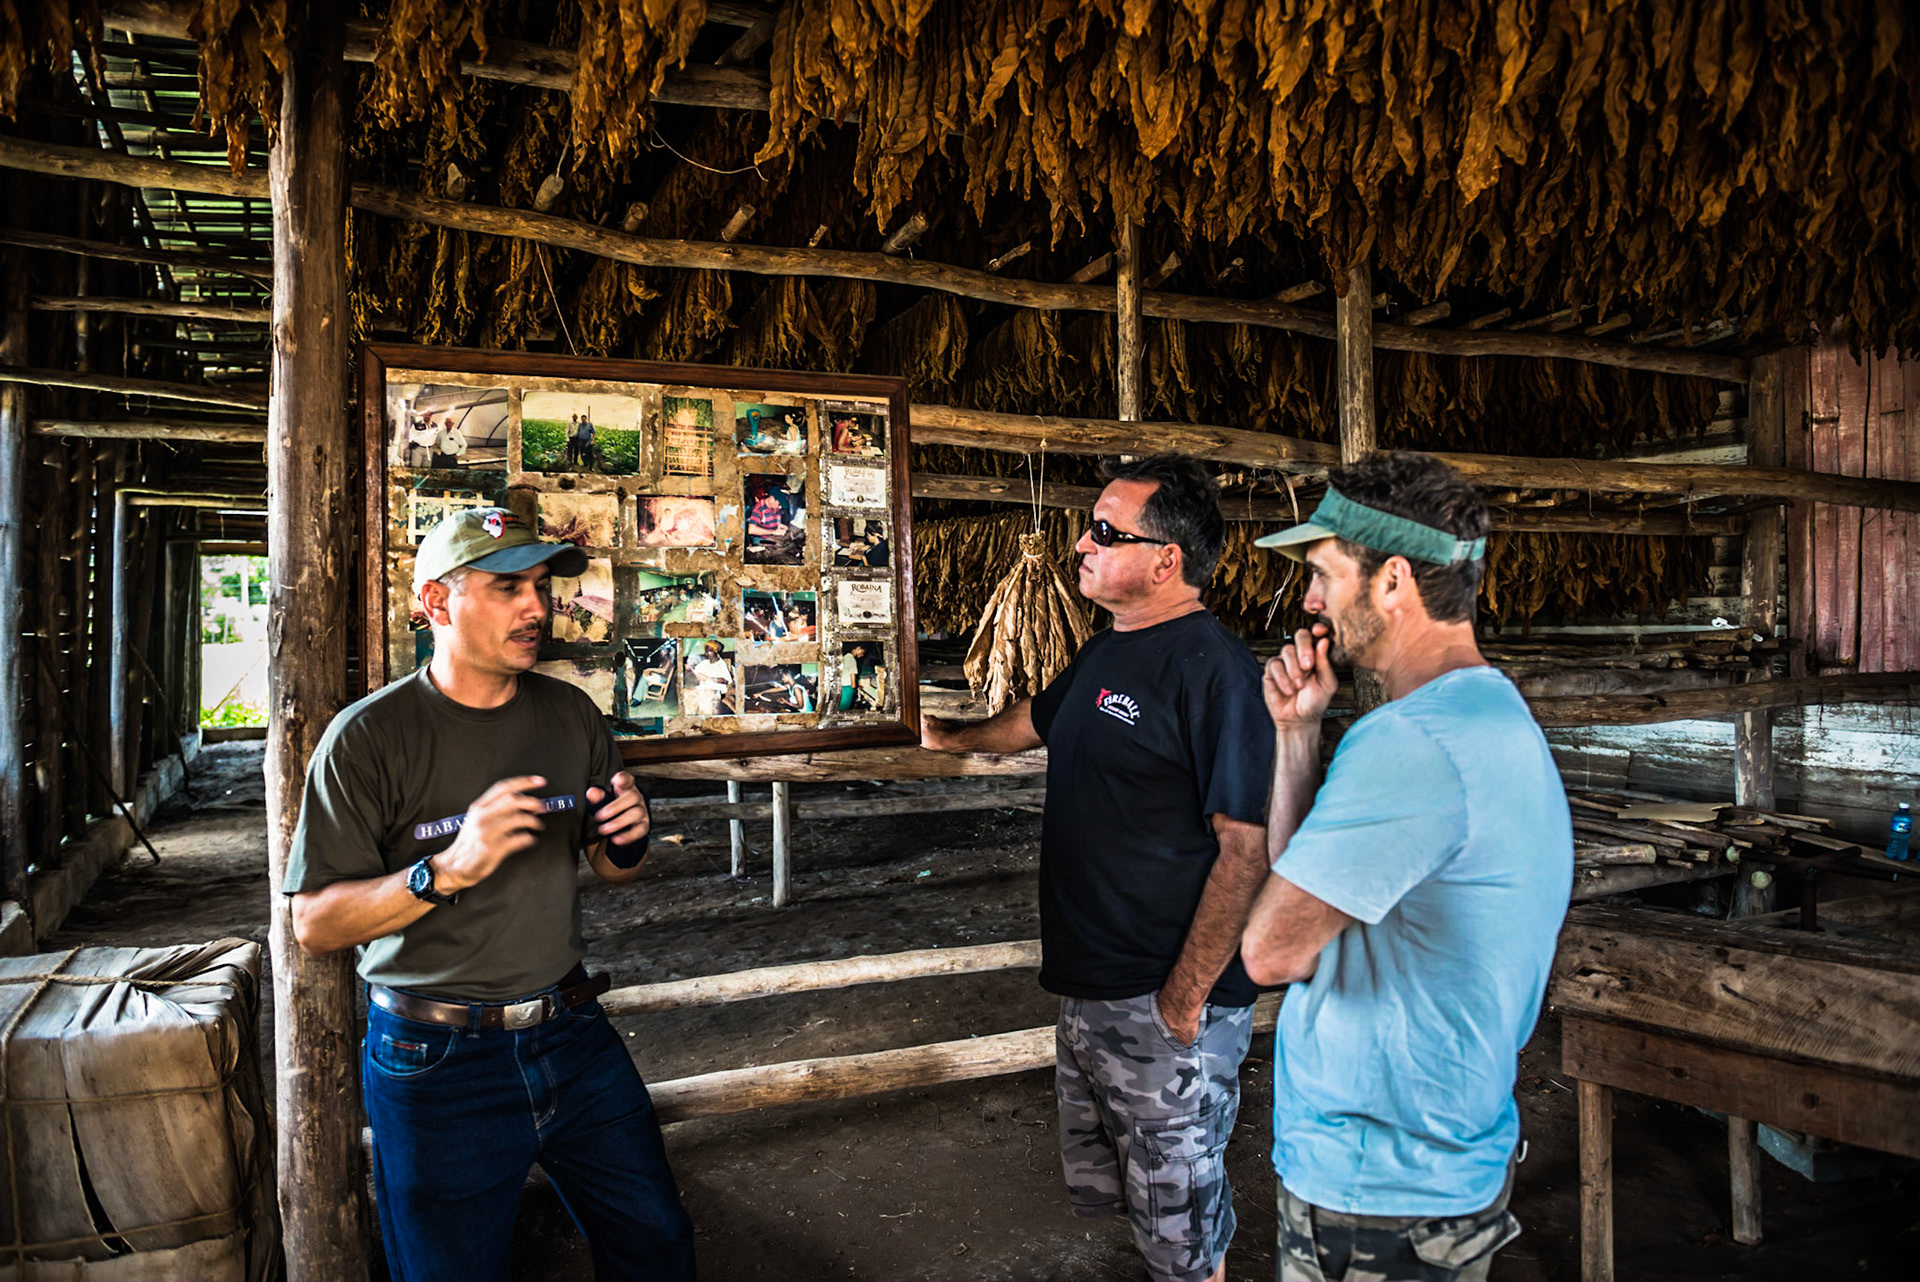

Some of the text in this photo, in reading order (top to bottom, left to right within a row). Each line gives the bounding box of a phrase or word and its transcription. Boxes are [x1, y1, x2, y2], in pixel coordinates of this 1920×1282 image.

[851, 583, 882, 593] ROBAINA
[1103, 693, 1140, 719] FIREBALL
[421, 798, 575, 838] HABA UBA
